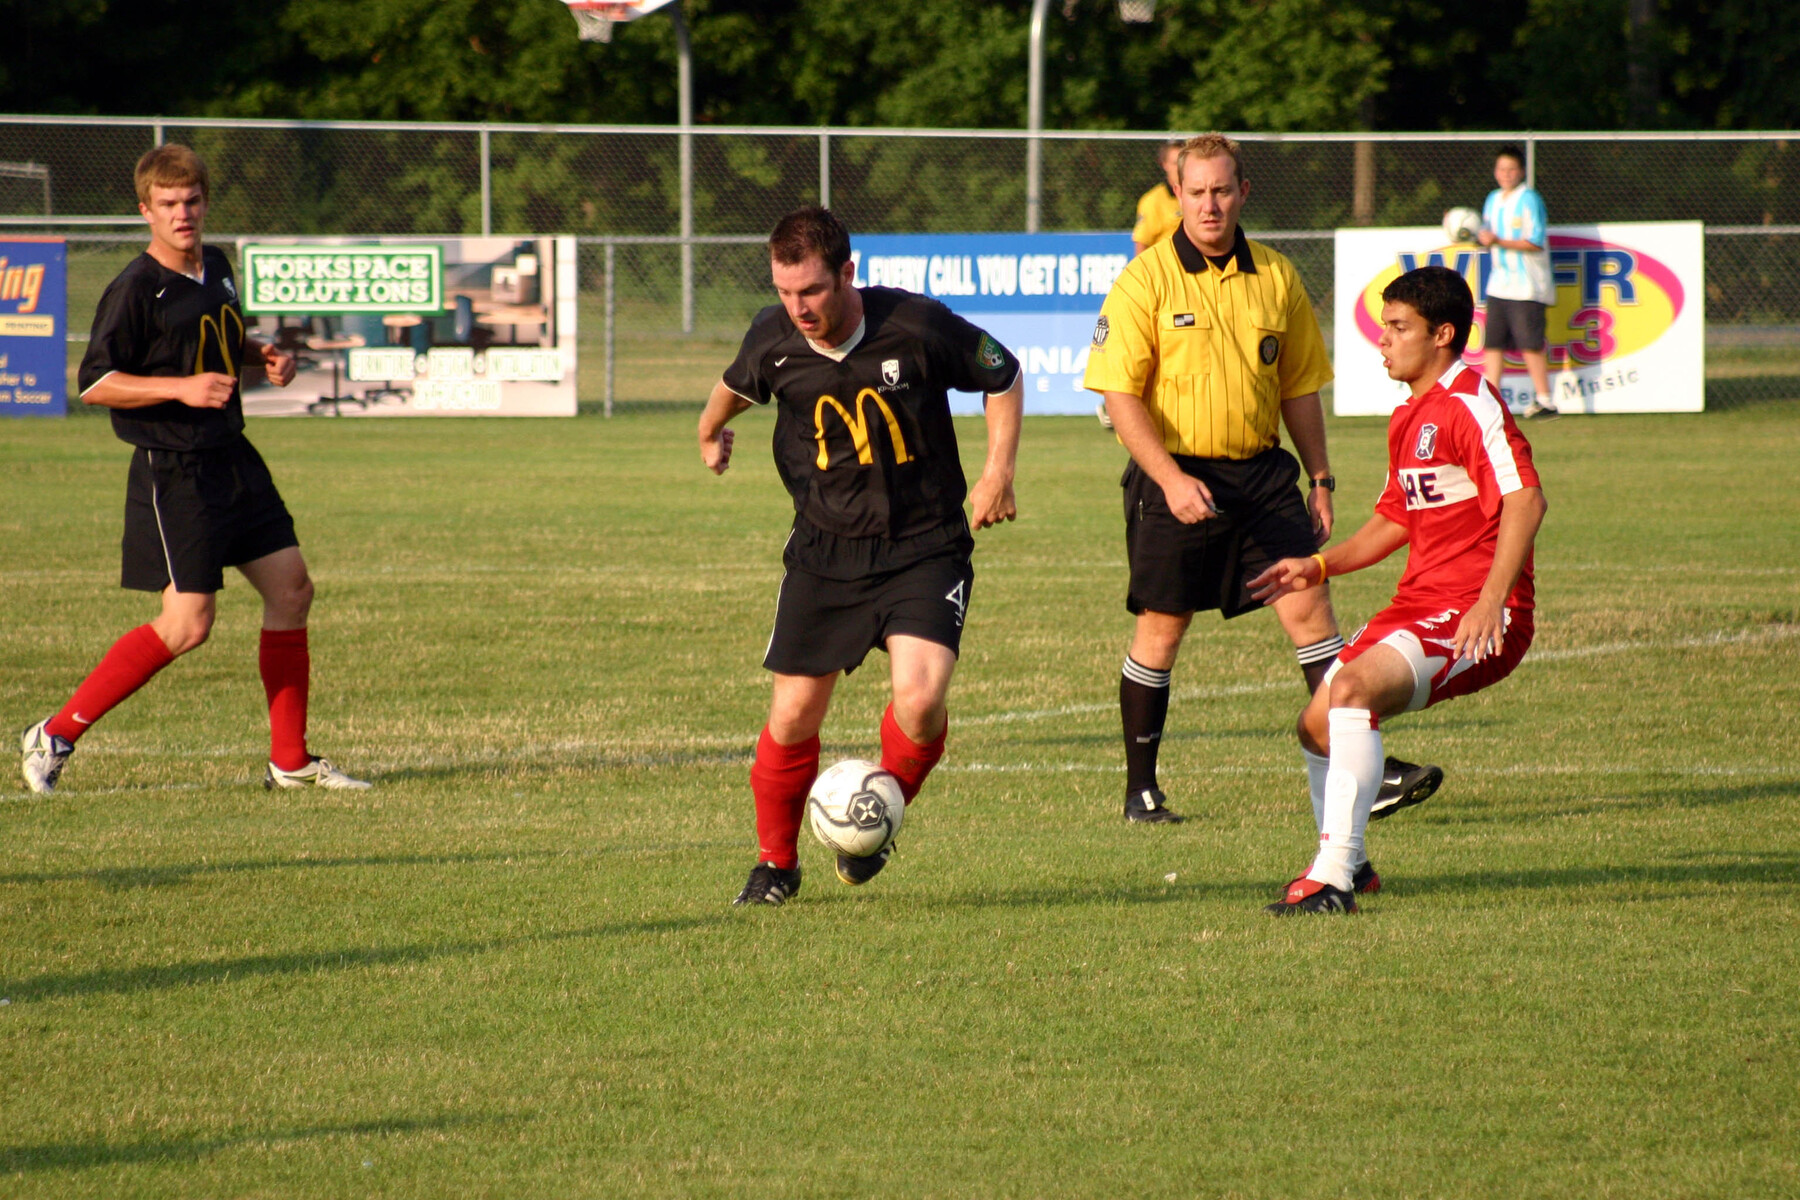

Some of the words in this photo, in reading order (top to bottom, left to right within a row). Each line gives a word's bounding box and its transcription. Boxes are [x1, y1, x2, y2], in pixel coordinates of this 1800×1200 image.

[255, 256, 430, 279] WORKSPACE
[868, 255, 928, 295] EVERY
[929, 255, 976, 295] CALL
[977, 256, 1018, 296] YOU
[1019, 254, 1057, 296] GET
[1058, 254, 1079, 296] IS
[258, 280, 430, 303] SOLUTIONS
[14, 388, 52, 404] Soccer
[1562, 369, 1640, 400] Music
[1500, 388, 1540, 406] Be
